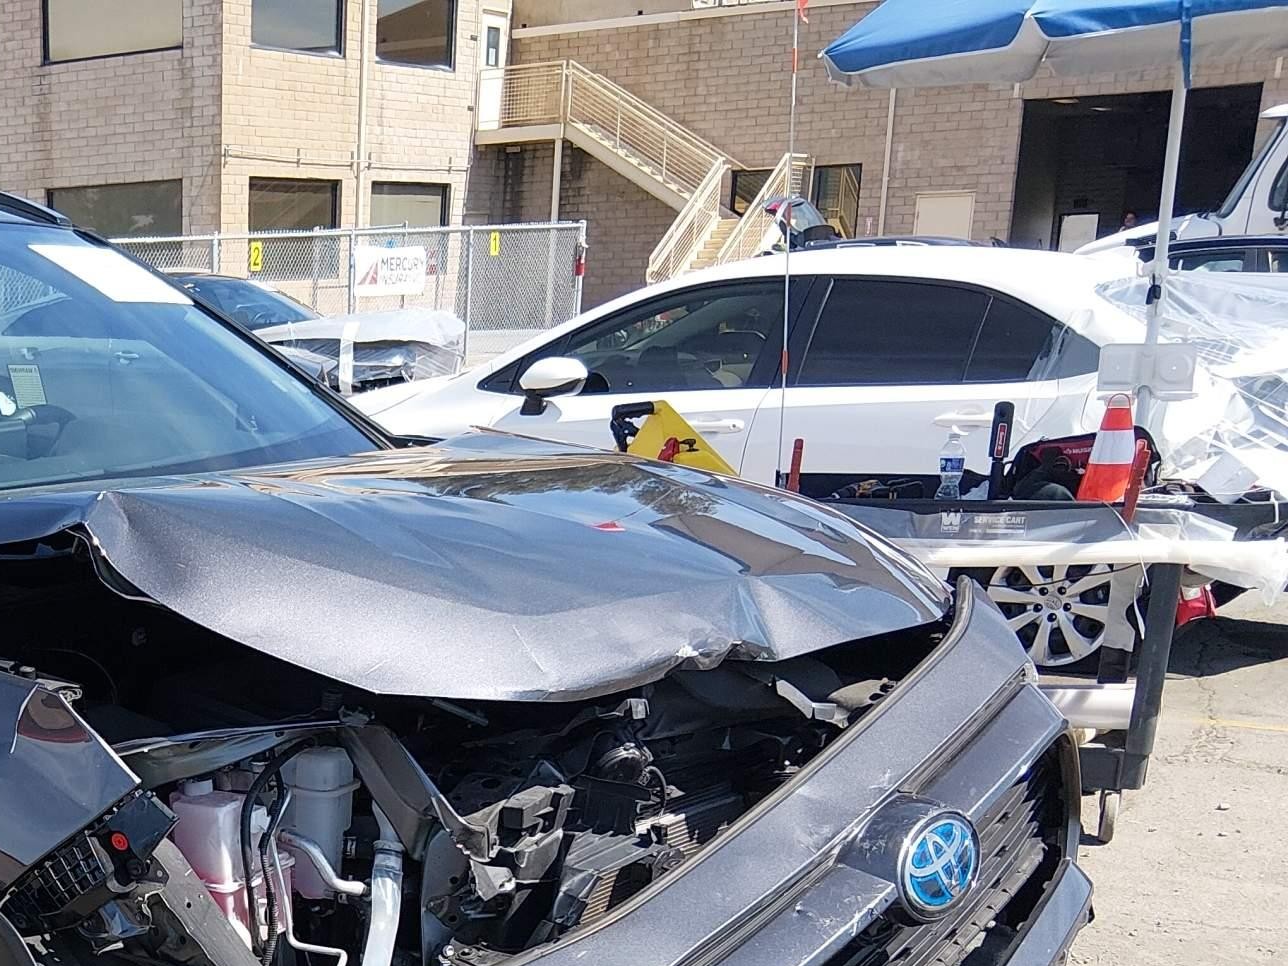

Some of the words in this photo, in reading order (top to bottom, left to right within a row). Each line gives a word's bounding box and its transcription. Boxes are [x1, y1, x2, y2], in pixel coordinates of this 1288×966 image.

[252, 246, 260, 267] 2
[380, 256, 424, 272] MERCURY
[974, 516, 1004, 524] SERVICE
[1006, 515, 1026, 524] CART
